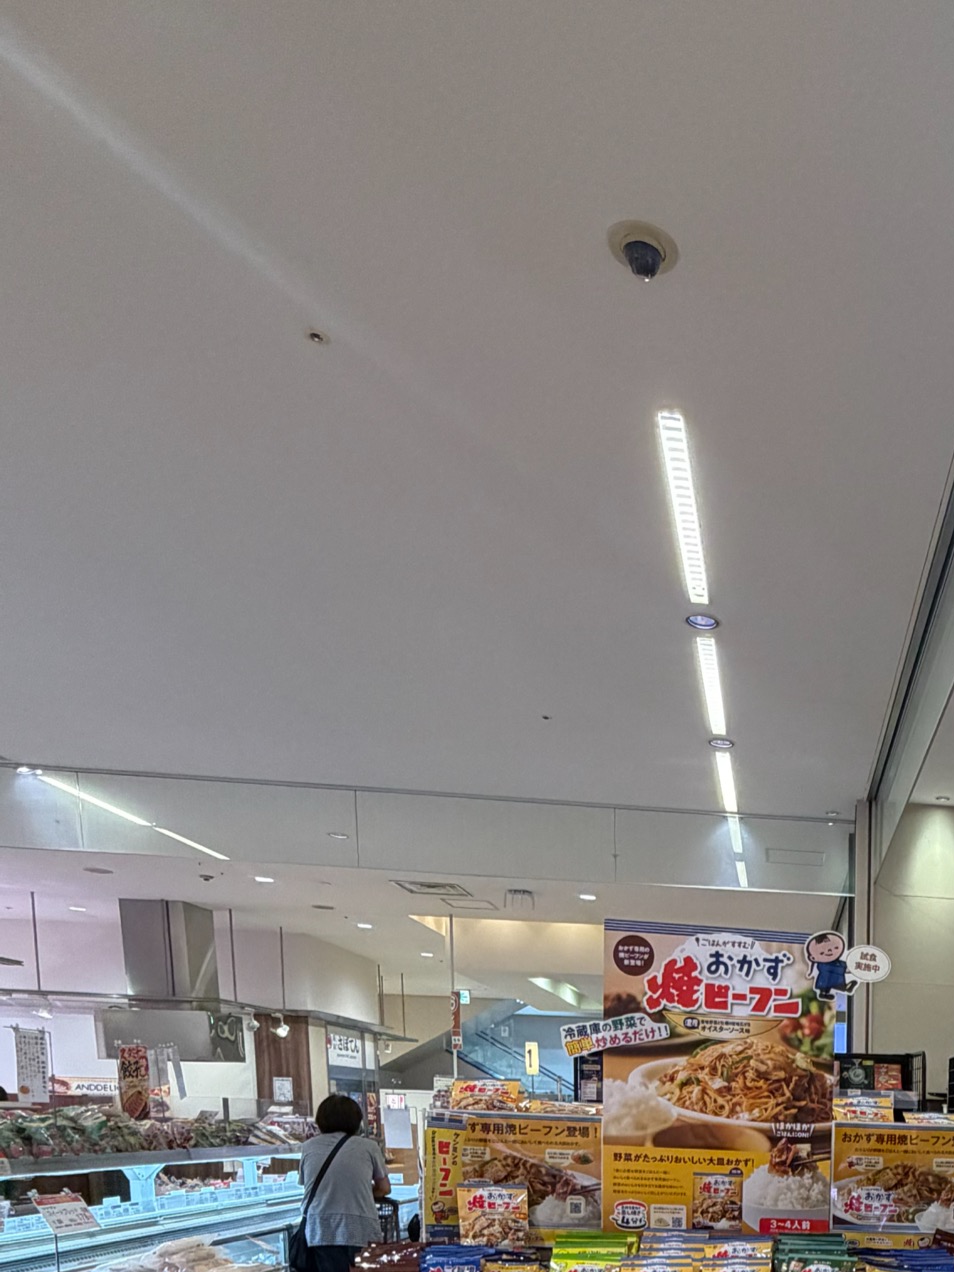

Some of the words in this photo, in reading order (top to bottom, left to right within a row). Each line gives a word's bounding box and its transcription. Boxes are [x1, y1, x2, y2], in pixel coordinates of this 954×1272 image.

[707, 951, 792, 982] おかず
[854, 961, 880, 973] 実施中
[860, 951, 877, 962] 試食
[646, 956, 799, 1014] 焼ビーフン
[563, 1016, 646, 1039] 冷蔵庫の野菜で
[527, 1049, 532, 1068] 1
[438, 1141, 453, 1196] ビーフン
[613, 1153, 755, 1168] 野菜がたっぷりおいしい大皿おかず!
